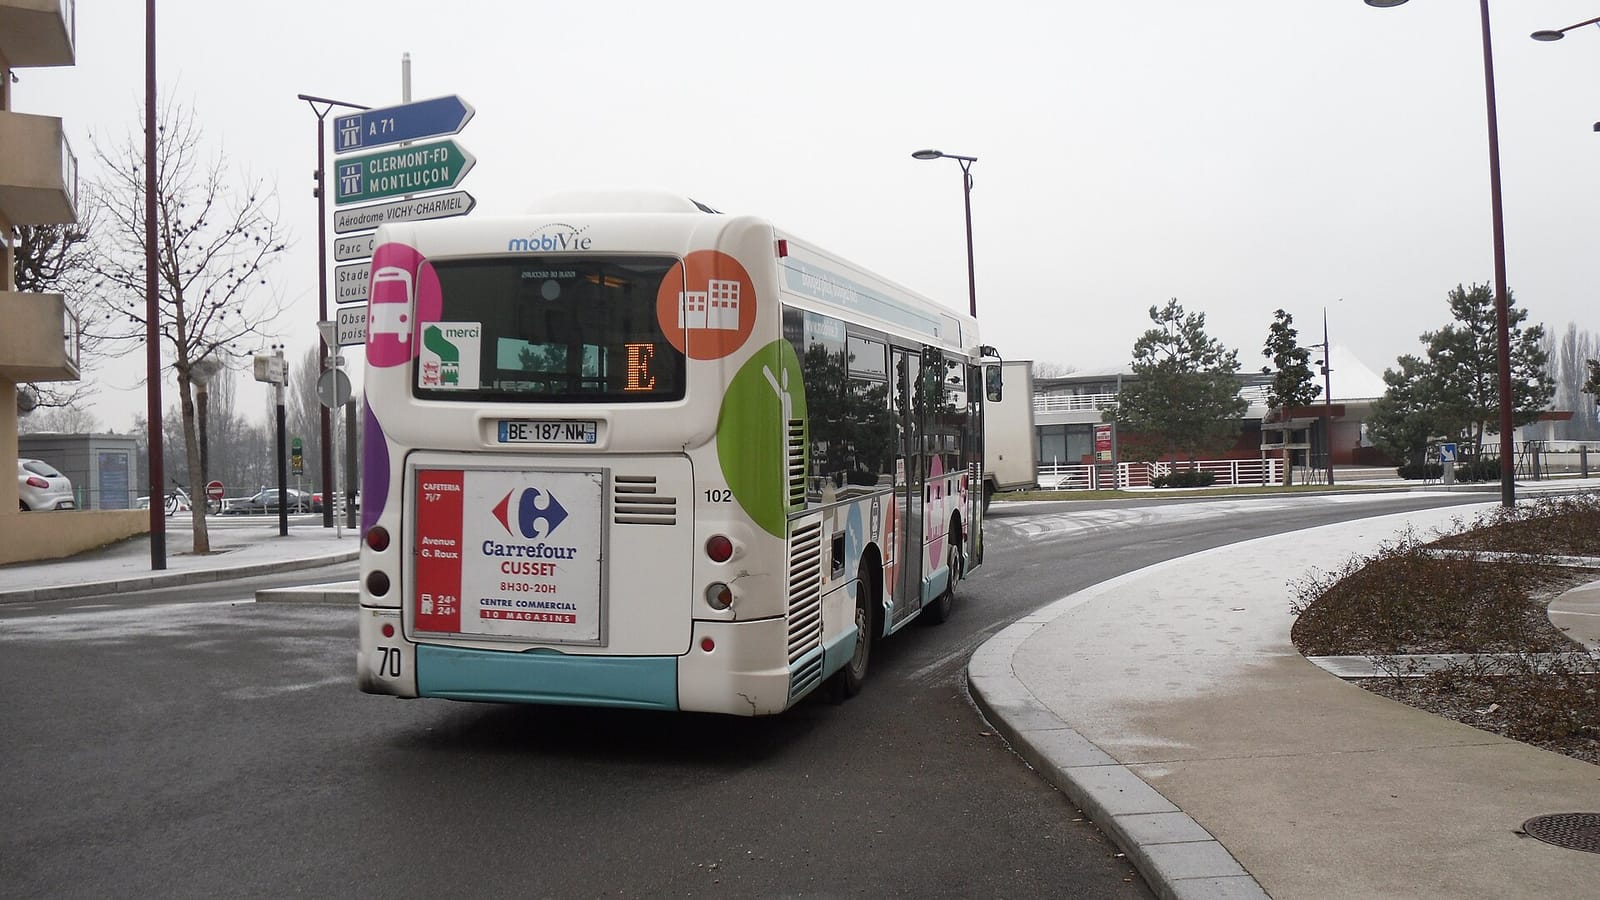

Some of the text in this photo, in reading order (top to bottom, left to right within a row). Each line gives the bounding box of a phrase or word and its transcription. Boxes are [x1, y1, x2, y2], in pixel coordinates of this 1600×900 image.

[369, 118, 394, 136] A 71
[369, 147, 448, 174] CLERMONT-FD
[369, 166, 449, 193] MONTLUÇON
[338, 198, 462, 228] Aérodrome VICHY-CHARMEIL
[508, 232, 592, 251] mobiVie
[339, 244, 361, 254] Parc
[340, 269, 369, 282] Stade
[340, 285, 367, 297] Louis
[341, 313, 366, 325] Obse
[446, 327, 480, 338] merci
[624, 343, 655, 391] E
[509, 423, 584, 440] BE-187-NW
[423, 483, 461, 491] CAFETERIA
[704, 489, 732, 503] 102
[422, 536, 456, 546] Avenue
[422, 548, 459, 559] G. Roux
[482, 540, 577, 560] Carrefour
[501, 561, 557, 577] CUSSET
[500, 581, 557, 594] 8H30-20H
[480, 598, 577, 611] CENTRE COMMERCIAL
[485, 610, 571, 623] 10 MAGASINS
[377, 646, 401, 677] 70
